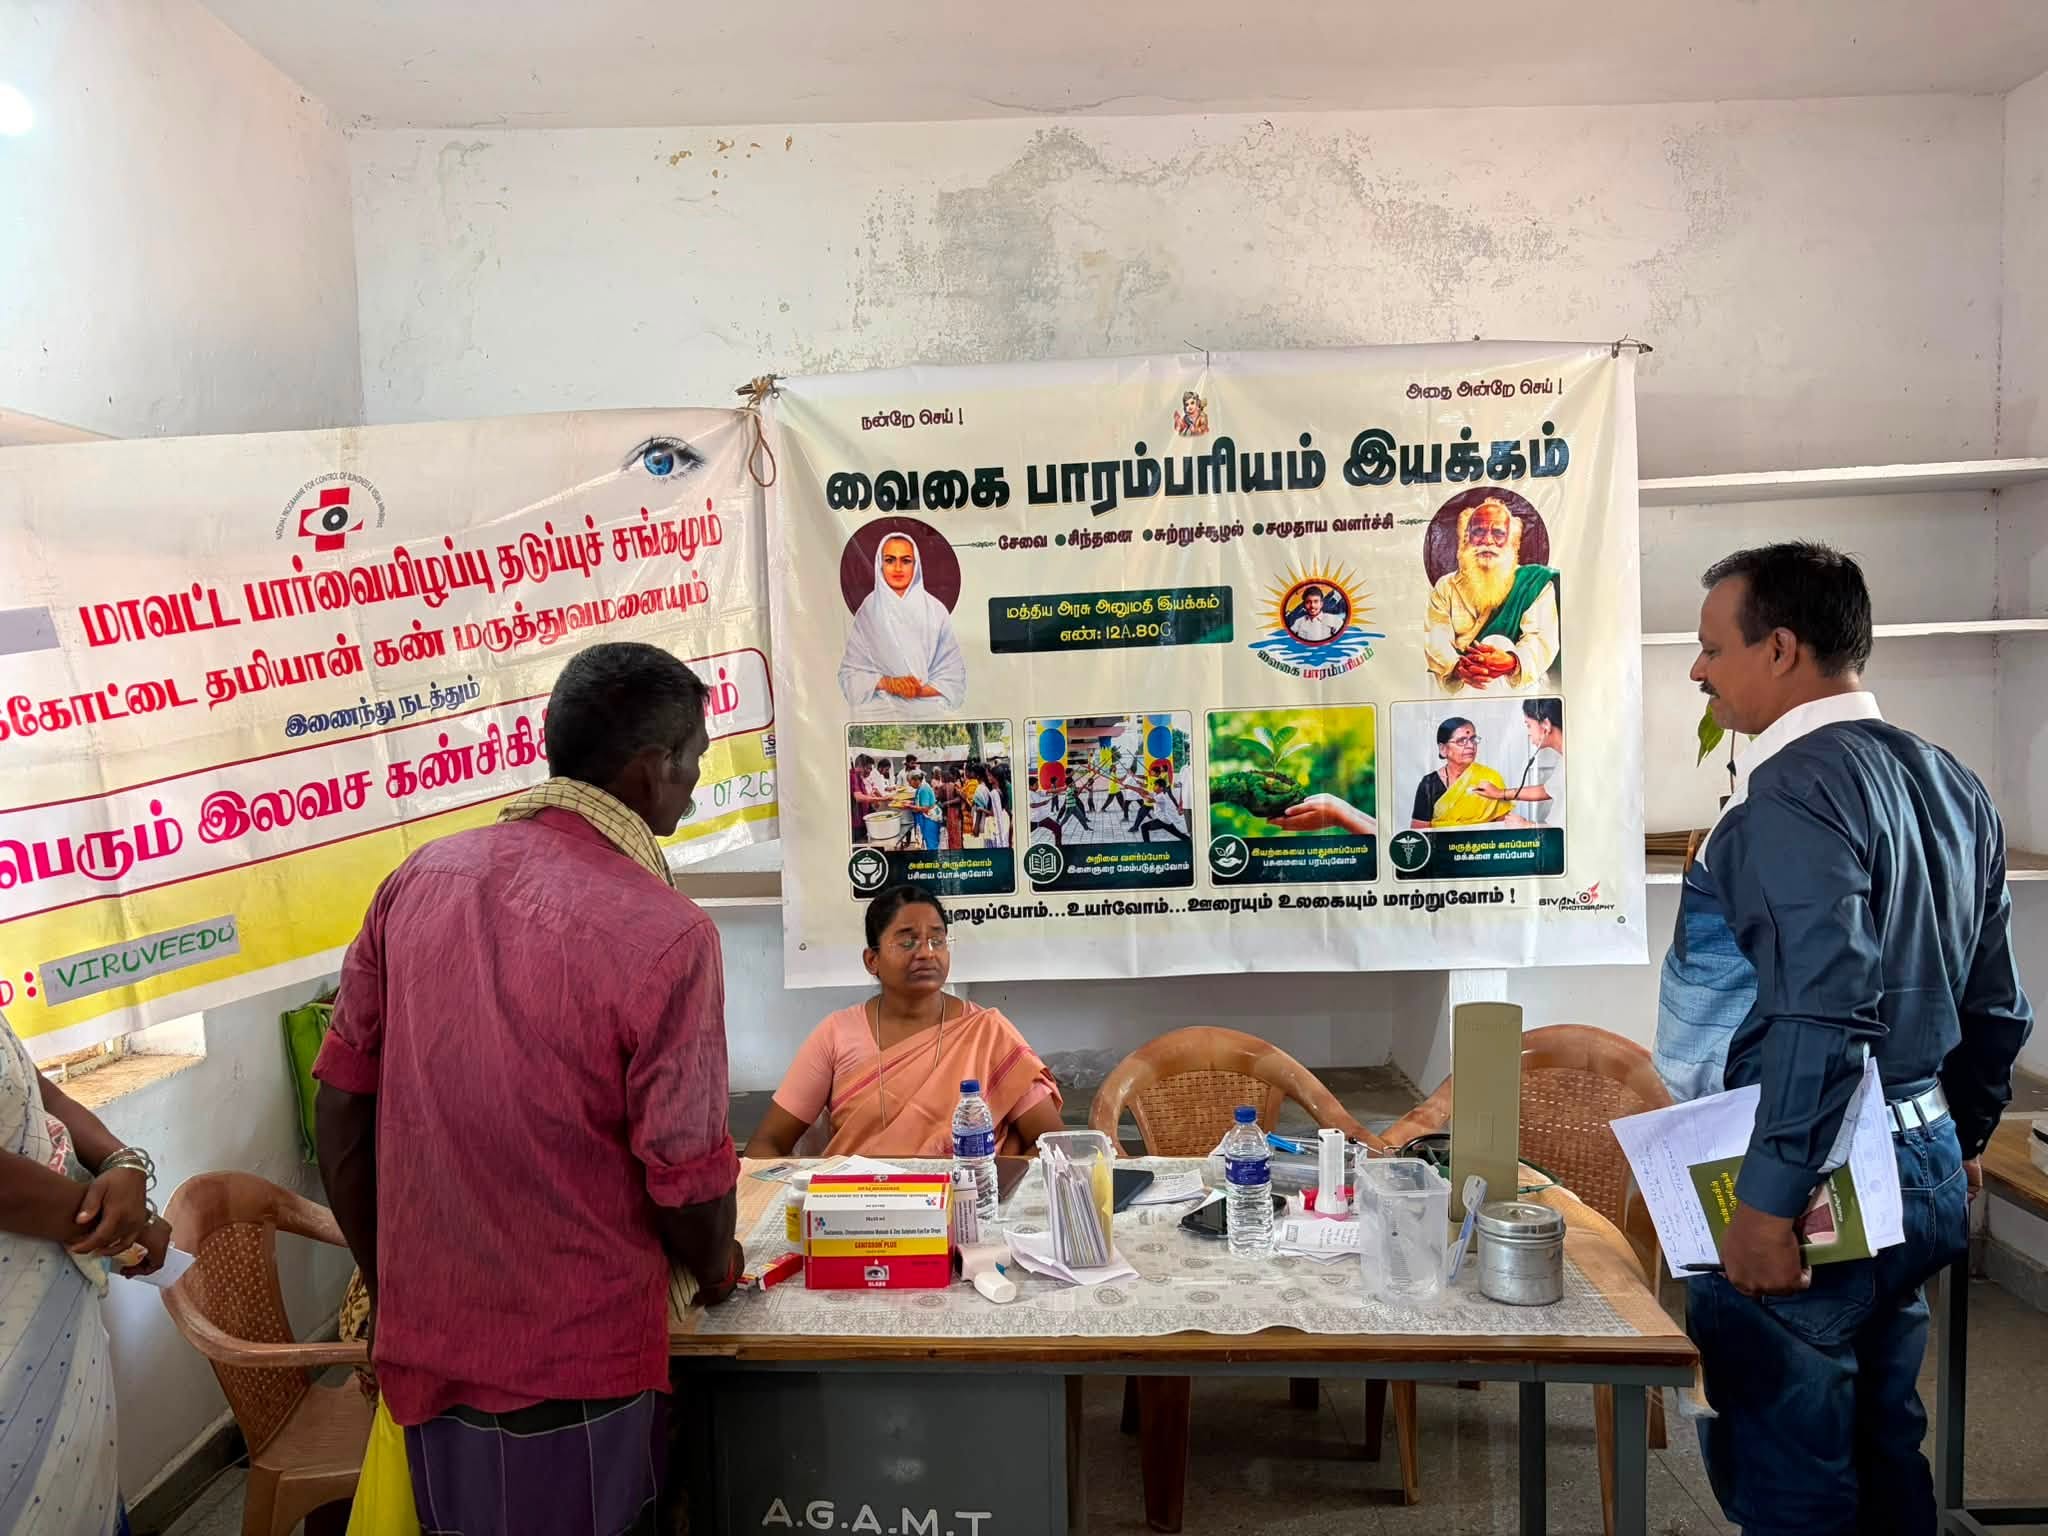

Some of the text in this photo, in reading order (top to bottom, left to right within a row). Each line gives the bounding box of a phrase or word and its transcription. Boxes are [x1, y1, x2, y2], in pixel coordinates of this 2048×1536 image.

[1405, 383, 1452, 400] அதை
[1457, 380, 1515, 398] அன்றே
[1519, 378, 1553, 396] செய்
[861, 410, 915, 431] நன்றே
[919, 409, 954, 426] செய்
[826, 421, 1570, 516] வைகை பாரம்பரியம் இயக்கம்
[998, 511, 1394, 551] சேவை சிந்தனை சுற்றுச்சூழல் சமுதாய வளர்ச்சி
[79, 498, 723, 648] மாவட்ட பார்வையிழப்பு தடுப்புச் சங்கமும்
[1006, 593, 1220, 621] மத்திய அரசு அனுமதி இயக்கம்
[205, 633, 365, 711] தமியான்
[373, 619, 446, 669] கண்
[453, 570, 710, 652] மருத்துவமனையும்
[1060, 624, 1102, 642] எண்:
[1257, 647, 1374, 680] வைகை பாரம்பரியம்
[285, 675, 481, 738] இணைந்து நடத்தும்
[198, 770, 374, 844] இலவச
[1498, 838, 1540, 849] காப்போம்
[1278, 891, 1376, 912] உலகையும்
[1383, 886, 1504, 911] மாற்றுவோம்
[56, 922, 235, 988] VIRUVEEDU
